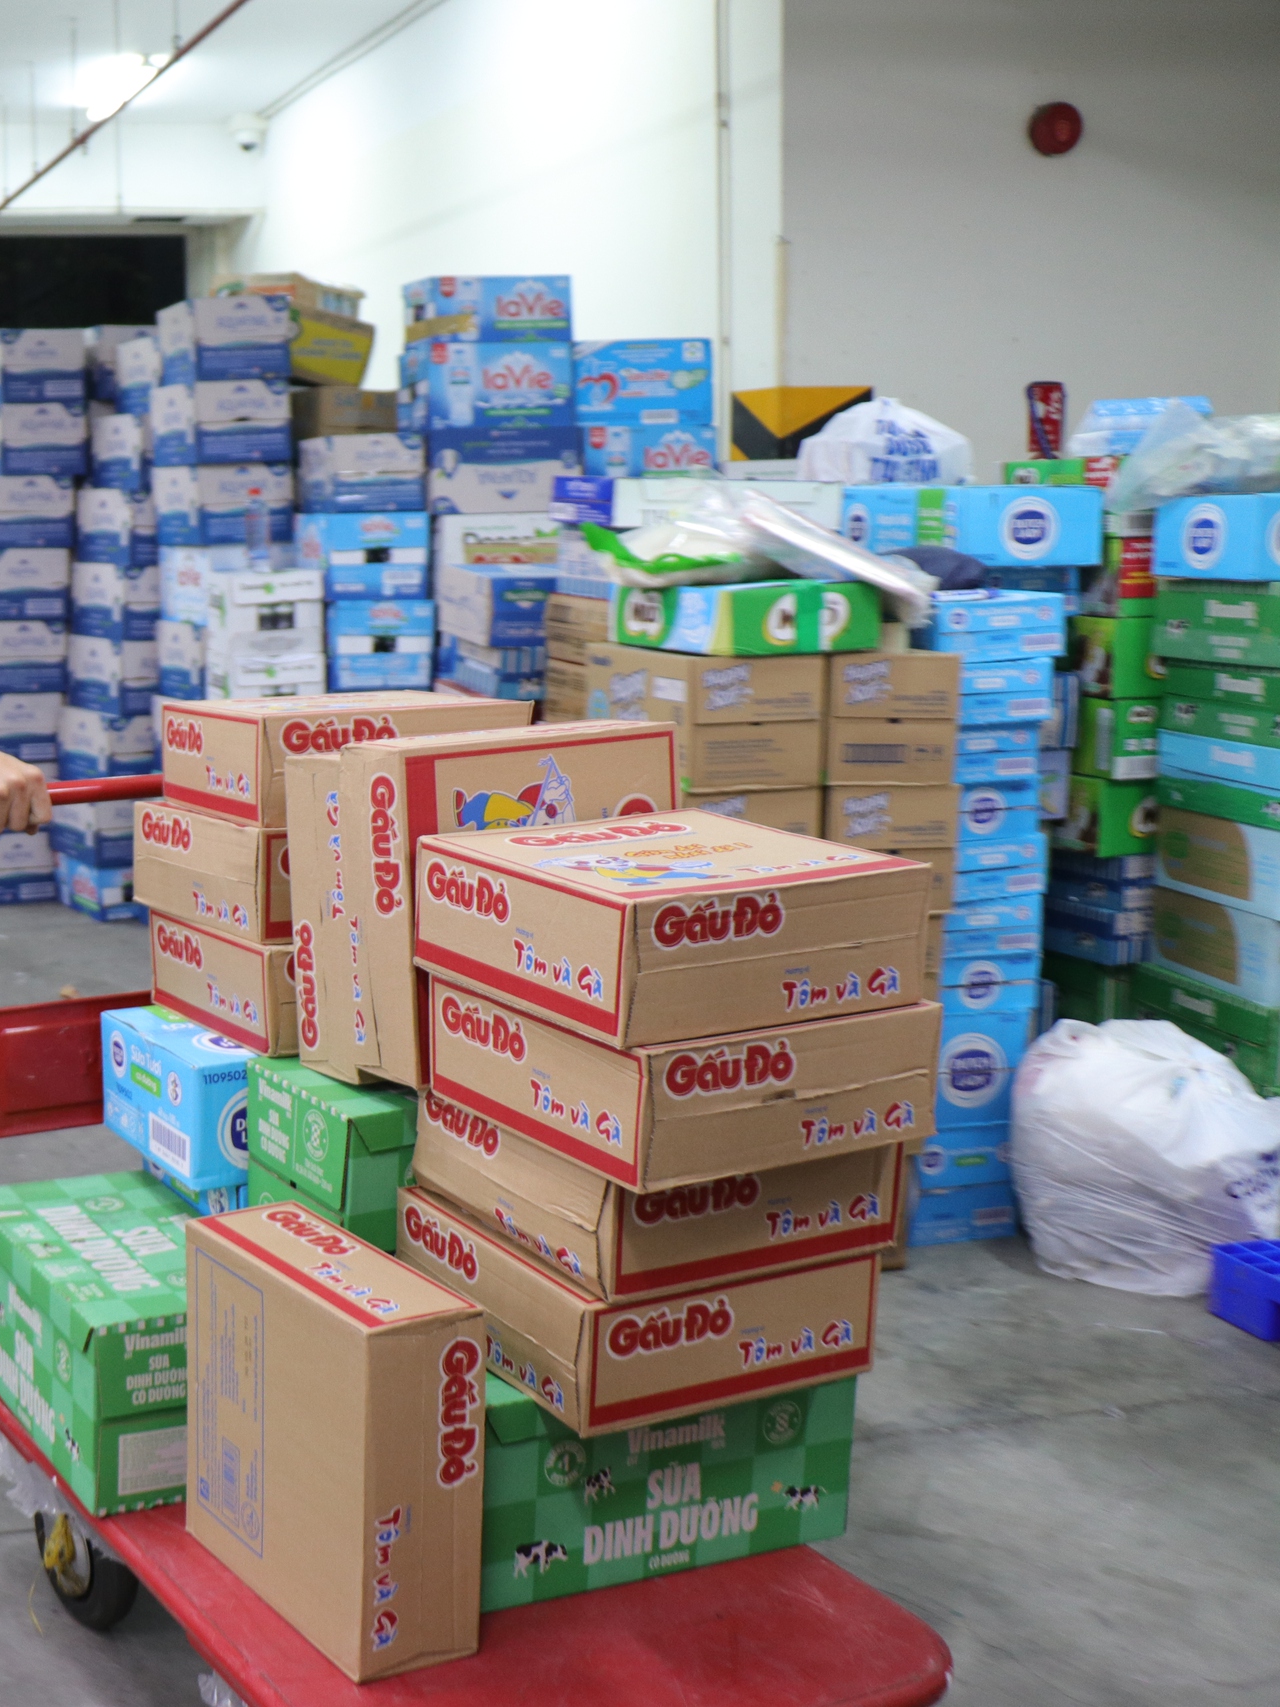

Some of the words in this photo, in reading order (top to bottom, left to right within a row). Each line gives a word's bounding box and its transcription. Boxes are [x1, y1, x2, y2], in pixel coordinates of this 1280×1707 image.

[513, 938, 548, 976] Tôm
[553, 957, 572, 988] và
[577, 965, 603, 1000] Gà
[782, 978, 828, 1011] Tôm
[836, 972, 860, 1004] và
[867, 966, 900, 996] Gà
[203, 1069, 247, 1086] 1109502
[530, 1078, 564, 1117] Tôm
[570, 1100, 590, 1131] và
[596, 1111, 622, 1147] Gà
[801, 1118, 845, 1150] Tôm
[852, 1108, 878, 1136] và
[884, 1101, 915, 1130] Gà
[766, 1209, 811, 1240] Tôm
[818, 1201, 841, 1229] và
[848, 1193, 880, 1222] Gà
[738, 1337, 783, 1370] Tôm
[790, 1327, 815, 1357] và
[822, 1319, 853, 1350] Gà
[583, 1513, 654, 1566] DINH
